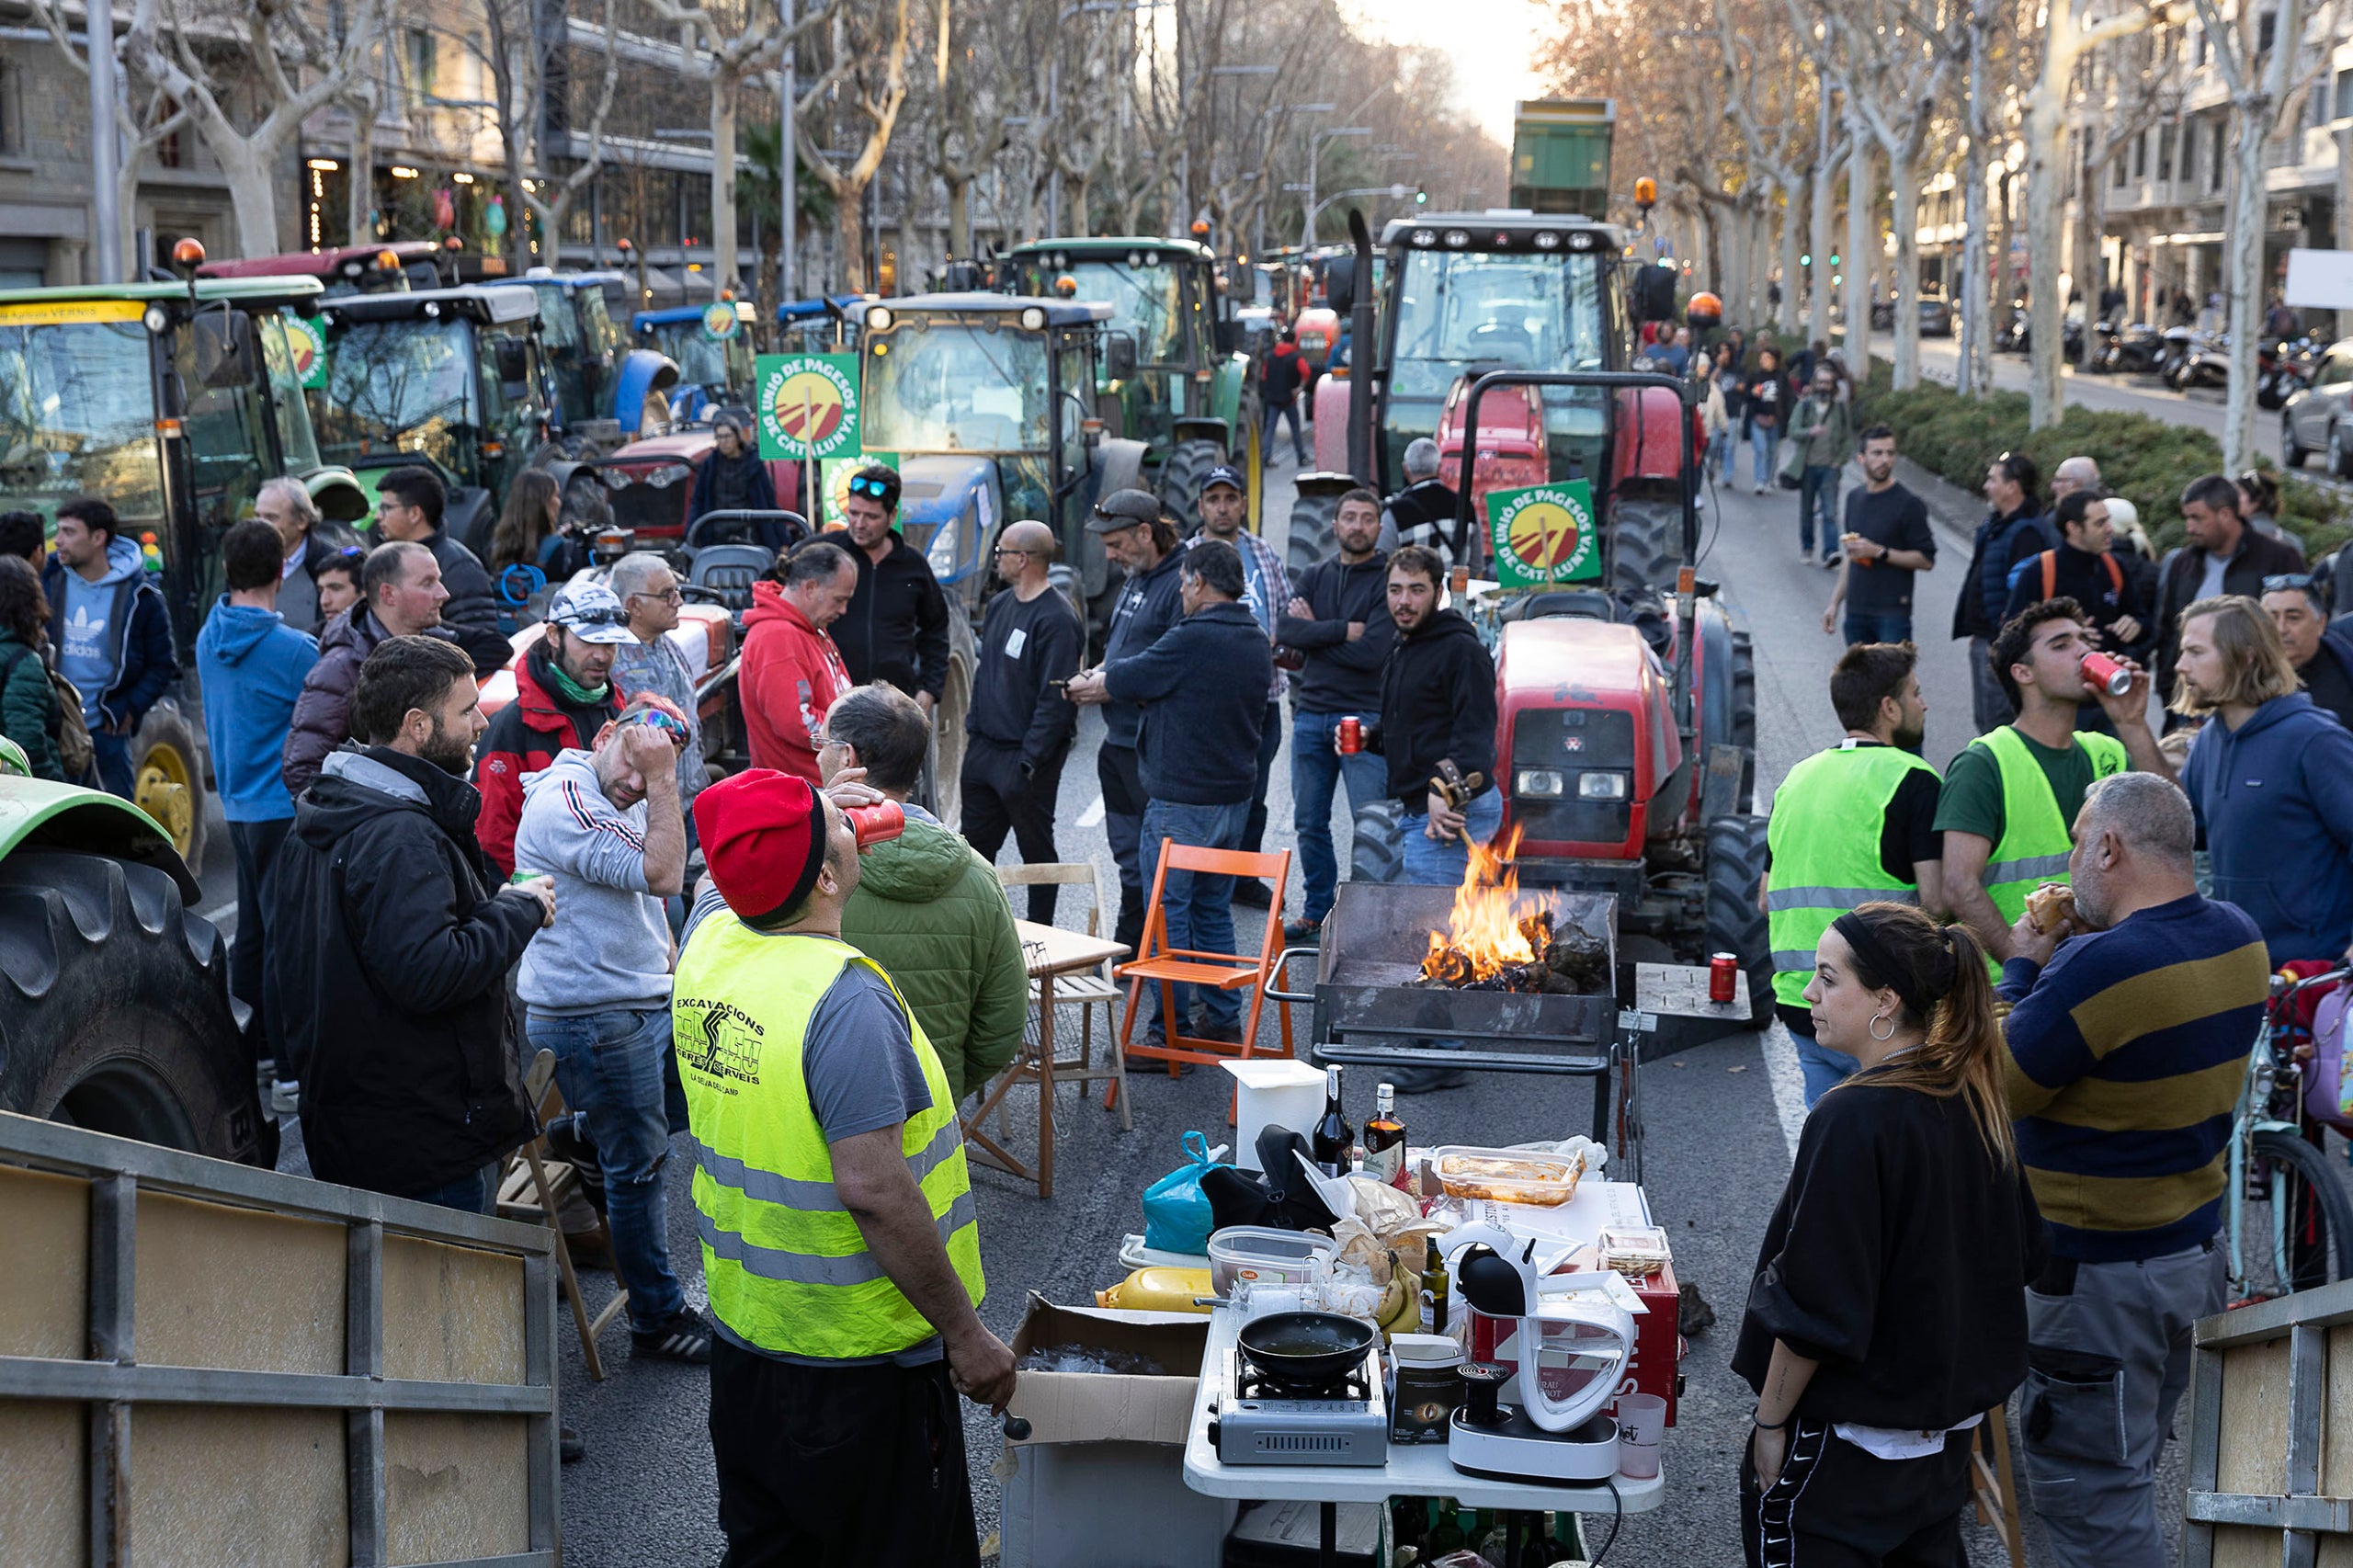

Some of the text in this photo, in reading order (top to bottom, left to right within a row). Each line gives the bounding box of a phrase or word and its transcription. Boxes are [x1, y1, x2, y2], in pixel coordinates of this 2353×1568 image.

[762, 358, 857, 411] UNIÓ DE PAGESOS
[763, 415, 781, 438] DE
[1495, 489, 1592, 544] UNIÓ DE PAGESOS
[1498, 546, 1518, 568] DE
[63, 641, 101, 660] adidas
[676, 998, 765, 1037] EXCAVACIONS
[713, 1062, 760, 1085] SERVEIS
